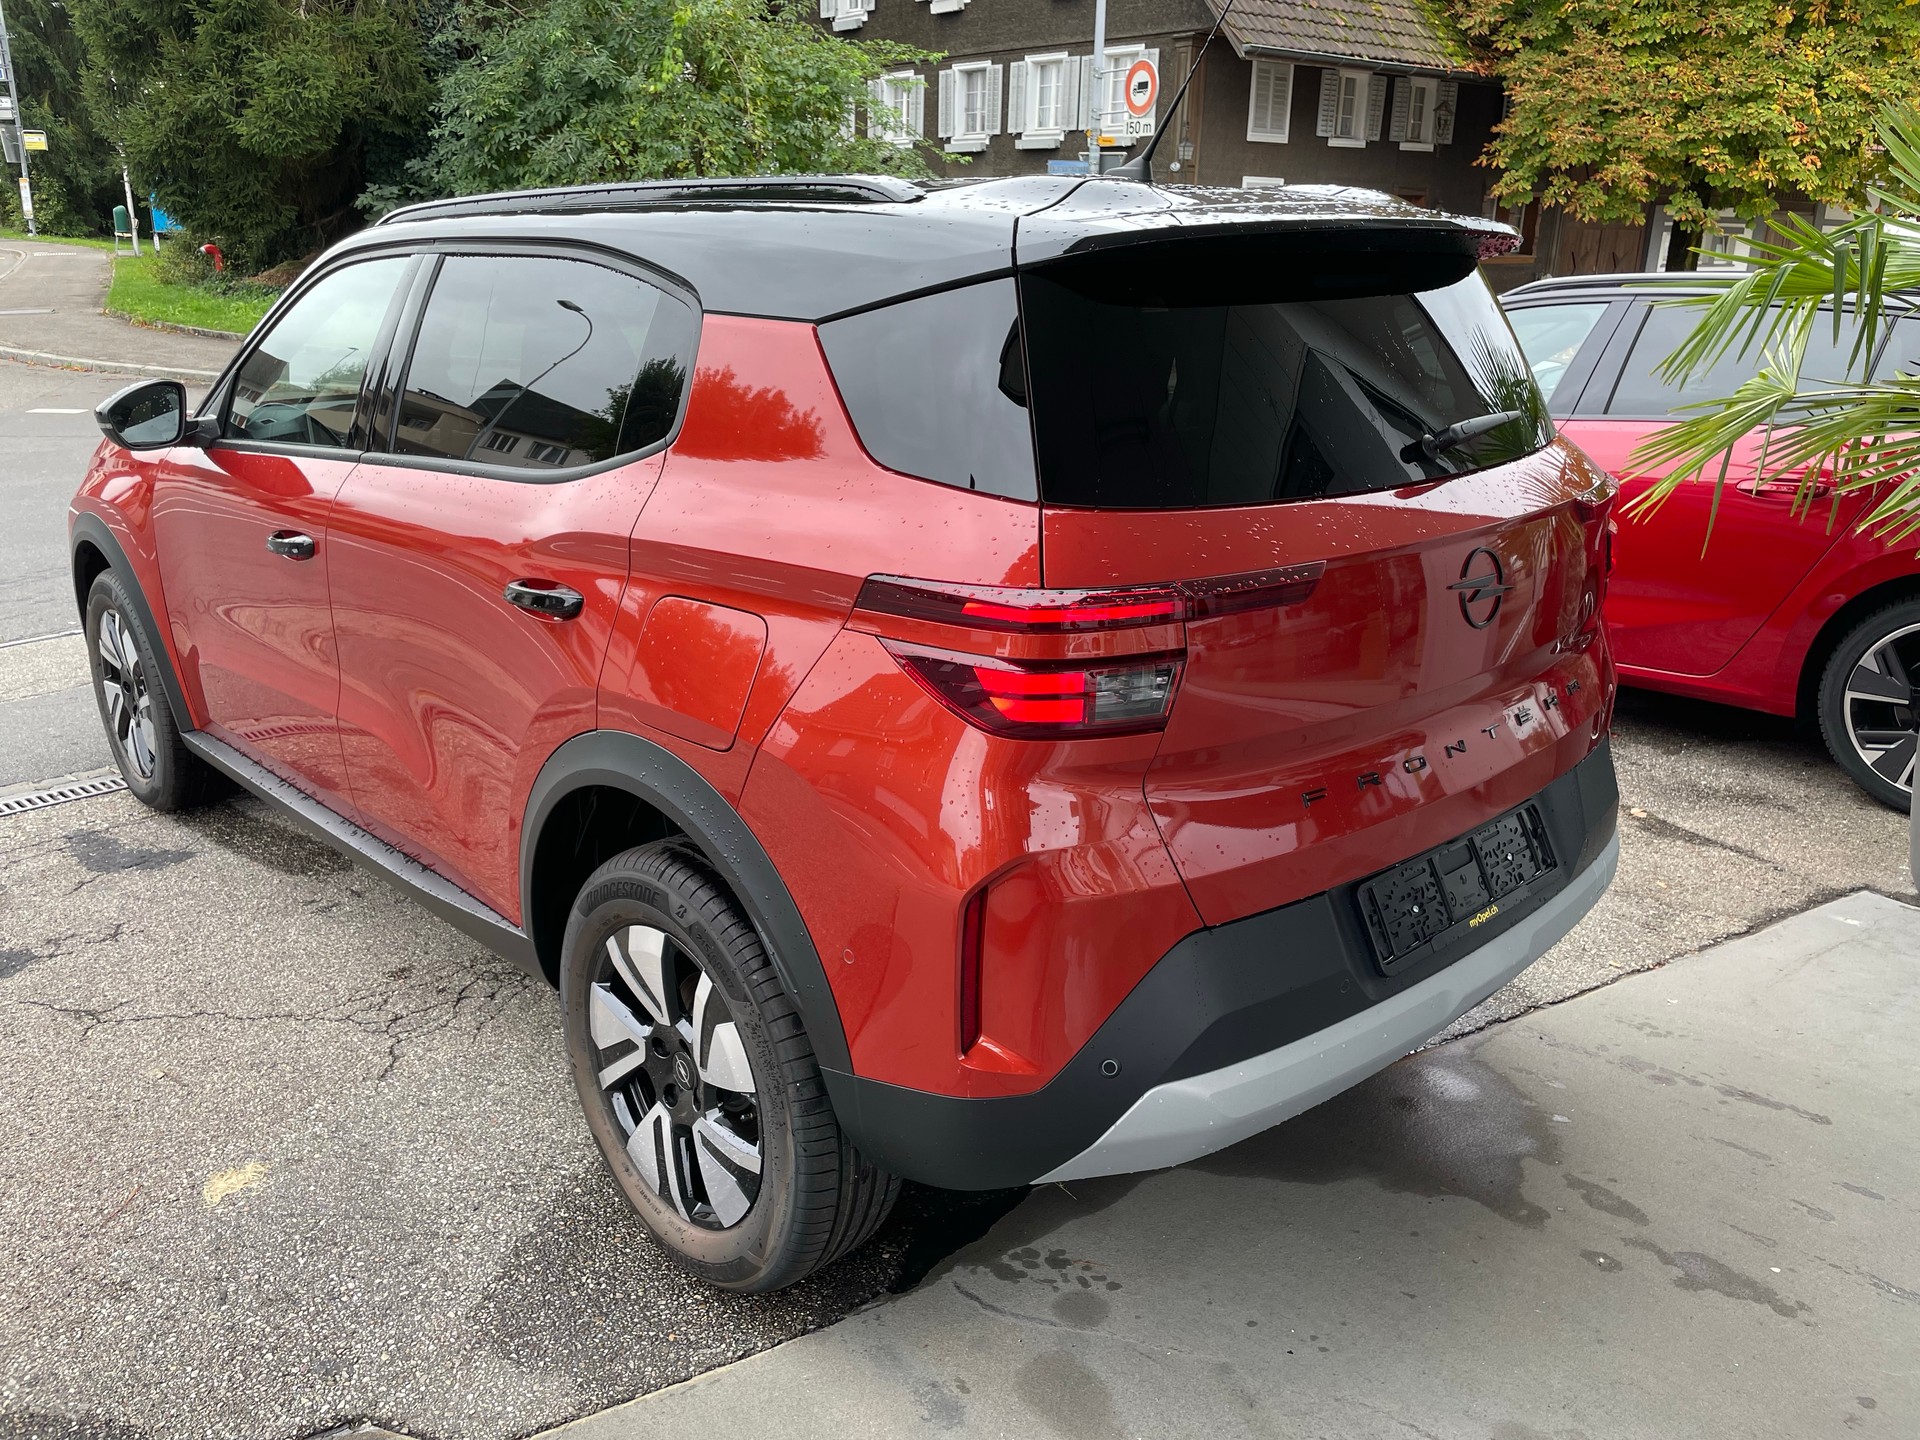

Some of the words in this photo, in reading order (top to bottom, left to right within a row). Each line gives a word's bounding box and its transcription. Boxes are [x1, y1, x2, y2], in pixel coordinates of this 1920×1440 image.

[1126, 121, 1140, 135] 150
[1142, 123, 1152, 134] m
[1302, 679, 1580, 808] FRONTERA
[586, 881, 662, 910] BRIDGESTONE
[1468, 904, 1499, 928] myOpel.ch
